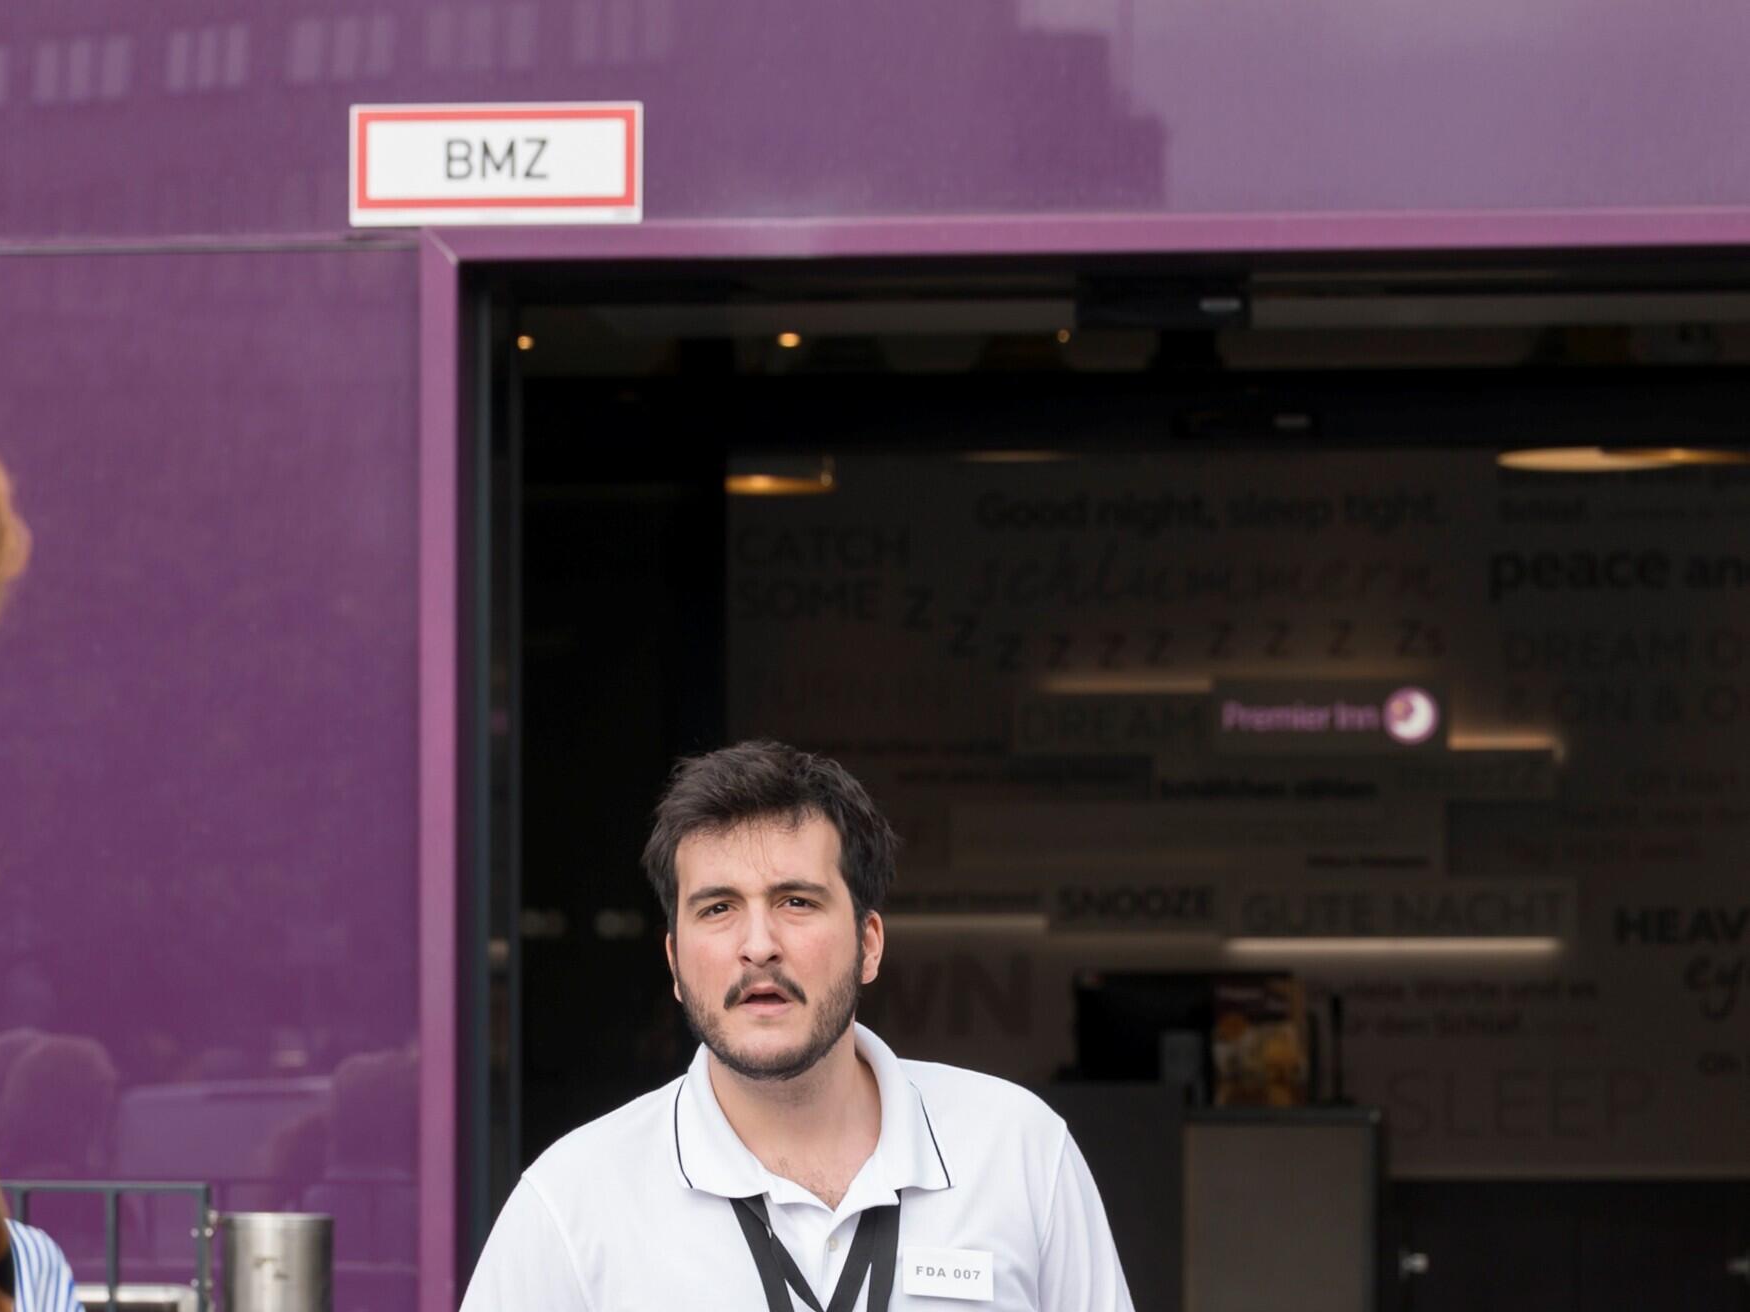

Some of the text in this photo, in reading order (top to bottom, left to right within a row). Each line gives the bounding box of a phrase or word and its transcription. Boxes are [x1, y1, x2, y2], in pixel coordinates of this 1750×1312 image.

[445, 137, 549, 181] BMZ
[974, 488, 1090, 531] Good
[1096, 488, 1219, 540] night,
[1225, 489, 1334, 535] sleep
[734, 522, 912, 570] CATCH
[1487, 548, 1750, 604] peace an
[734, 577, 884, 622] SOME
[1500, 628, 1690, 671] DREAM
[1220, 700, 1380, 732] Premier Inn
[1055, 883, 1217, 923] SNOOZE
[1240, 890, 1565, 936] GUTE NACHT
[1614, 905, 1750, 945] HEAV
[1682, 955, 1750, 1024] ey
[1386, 1067, 1655, 1140] SLEEP
[915, 1265, 981, 1280] FDA 007
